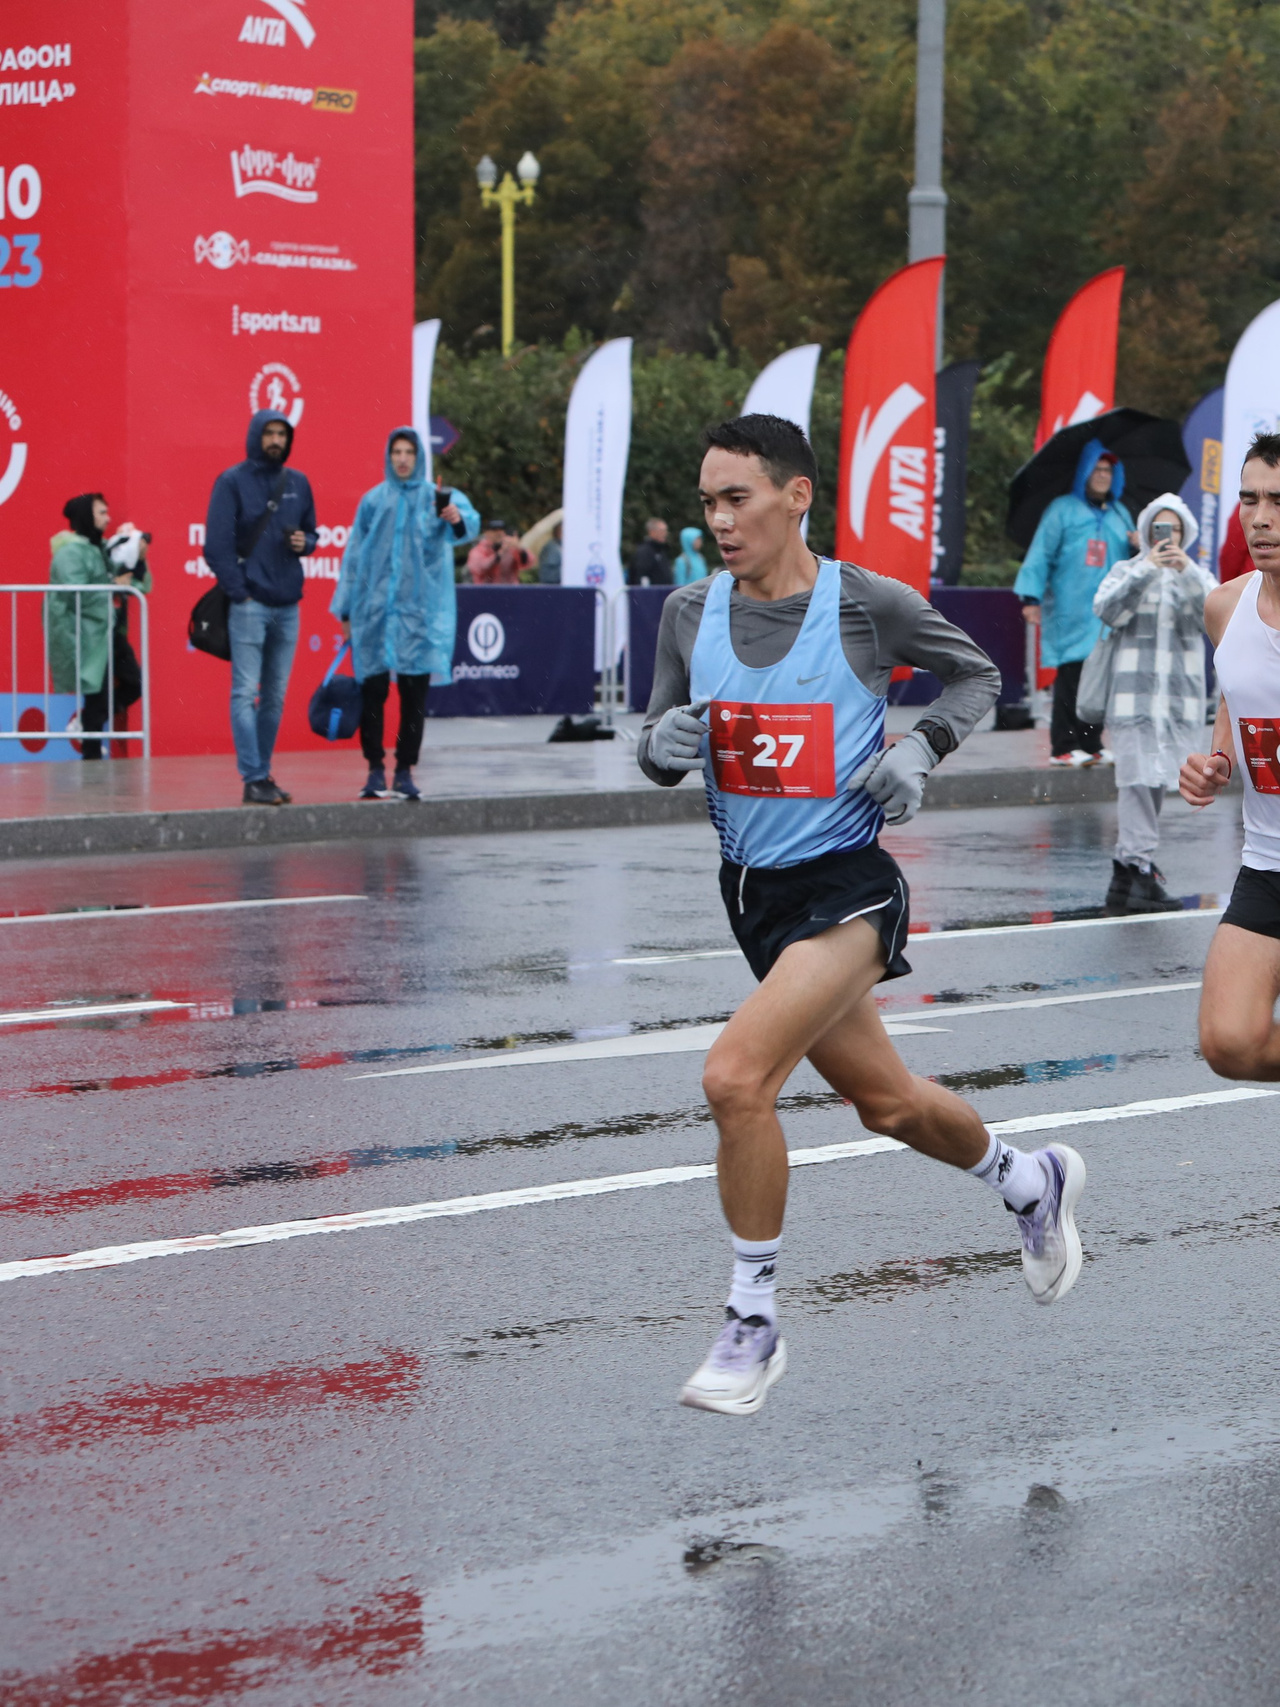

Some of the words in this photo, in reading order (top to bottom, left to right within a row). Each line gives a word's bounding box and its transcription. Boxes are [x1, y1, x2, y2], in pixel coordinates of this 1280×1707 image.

[238, 15, 286, 47] ANTA
[0, 43, 71, 71] АФОН
[316, 90, 354, 109] PRO
[240, 311, 321, 335] sports.ru
[889, 445, 927, 542] ANTA
[752, 733, 805, 768] 27
